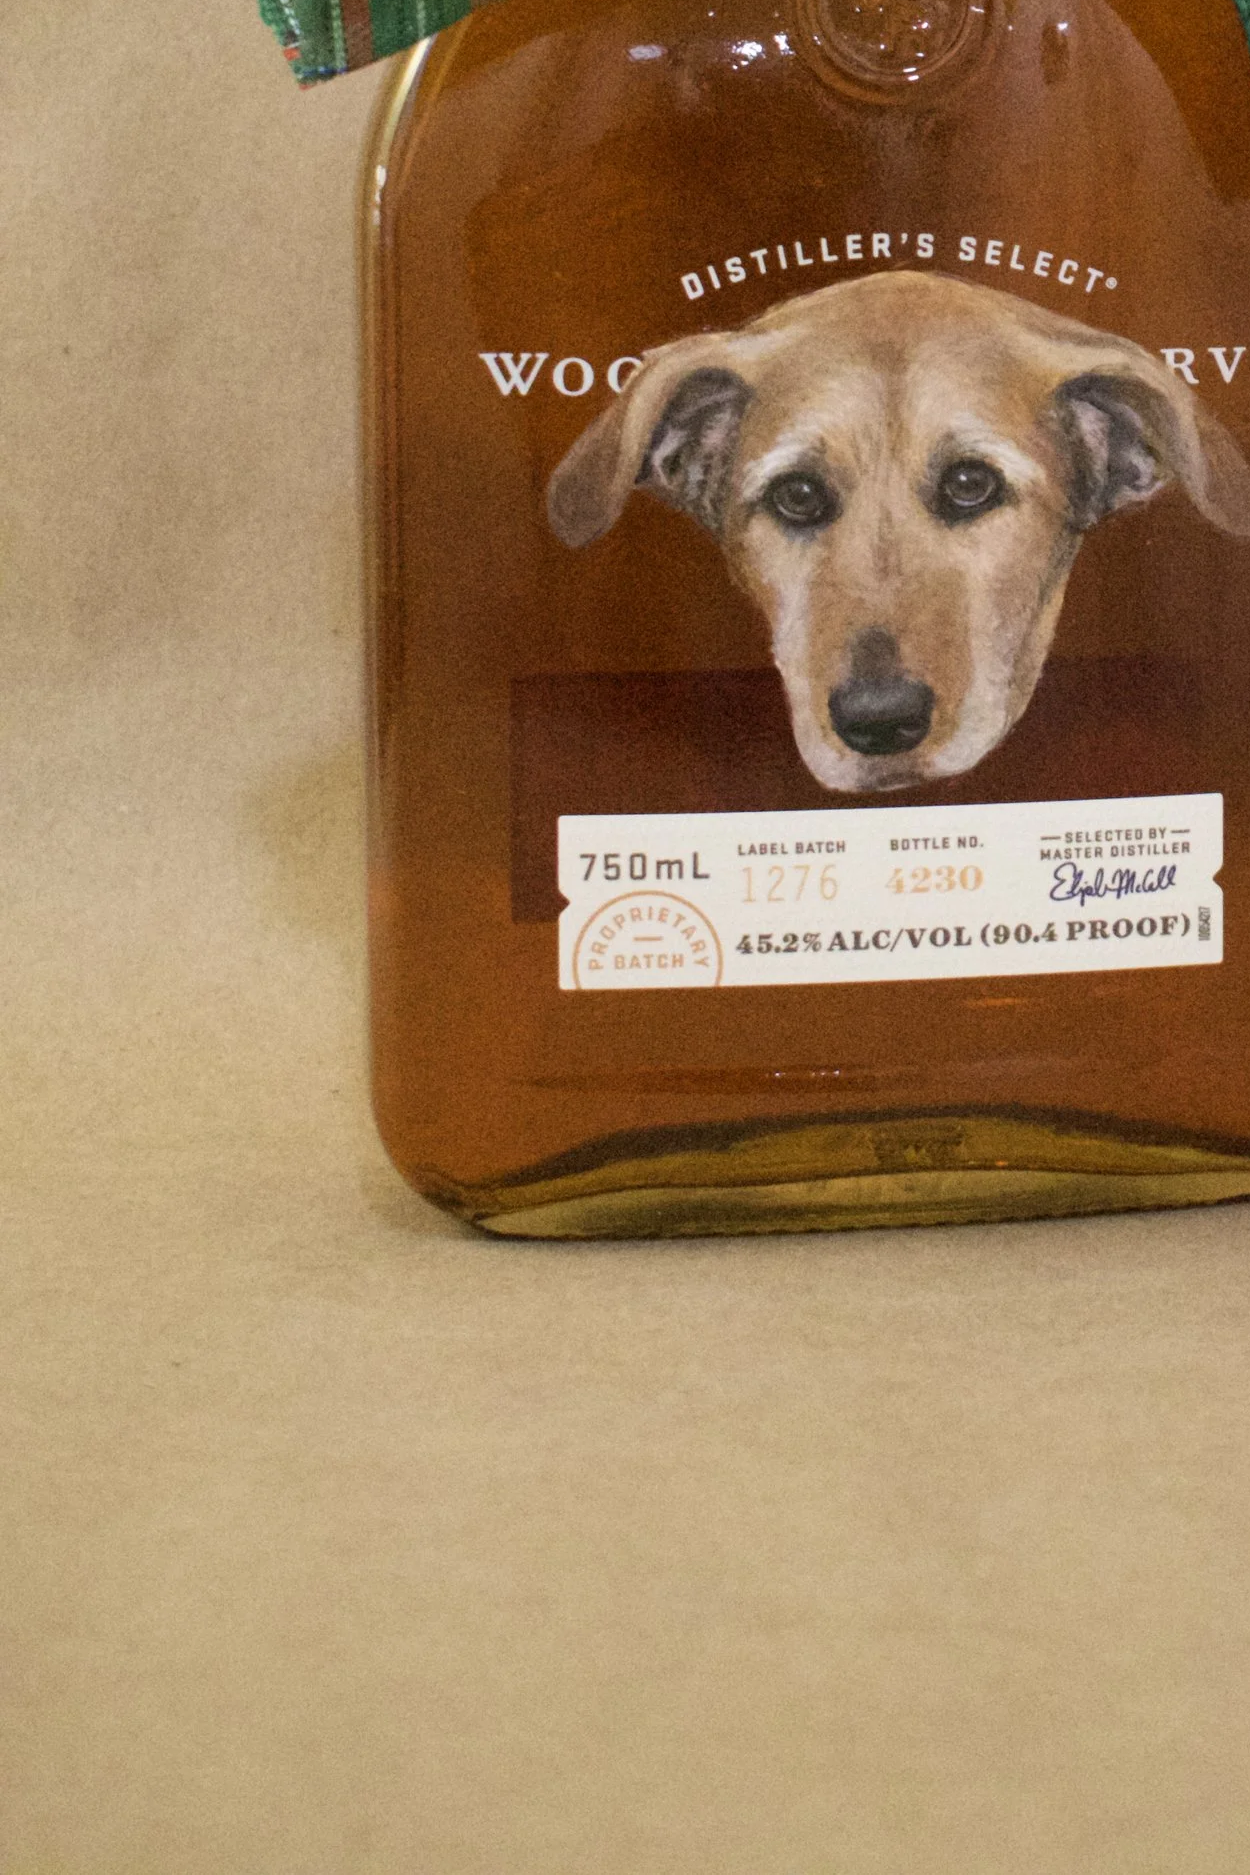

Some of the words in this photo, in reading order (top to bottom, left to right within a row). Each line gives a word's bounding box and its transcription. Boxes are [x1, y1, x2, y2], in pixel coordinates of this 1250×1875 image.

[680, 232, 936, 301] DISTILLER'S
[738, 841, 789, 857] LABEL
[795, 840, 847, 855] BATCH
[890, 837, 951, 852] BOTTLE
[957, 836, 985, 849] NO.
[1064, 828, 1144, 844] SELECTED
[1149, 827, 1168, 840] BY
[1040, 846, 1104, 861] MASTER
[1110, 842, 1191, 858] DISTILLER
[579, 852, 711, 882] 750mL
[885, 864, 985, 895] 4230
[741, 864, 839, 903] 1276
[588, 905, 711, 971] PROPRIETARY
[736, 932, 822, 956] 45.2%
[828, 926, 973, 953] ALC/VOL
[980, 923, 1058, 948] (90.4
[1066, 913, 1191, 942] PROOF)
[614, 953, 685, 971] BATCH
